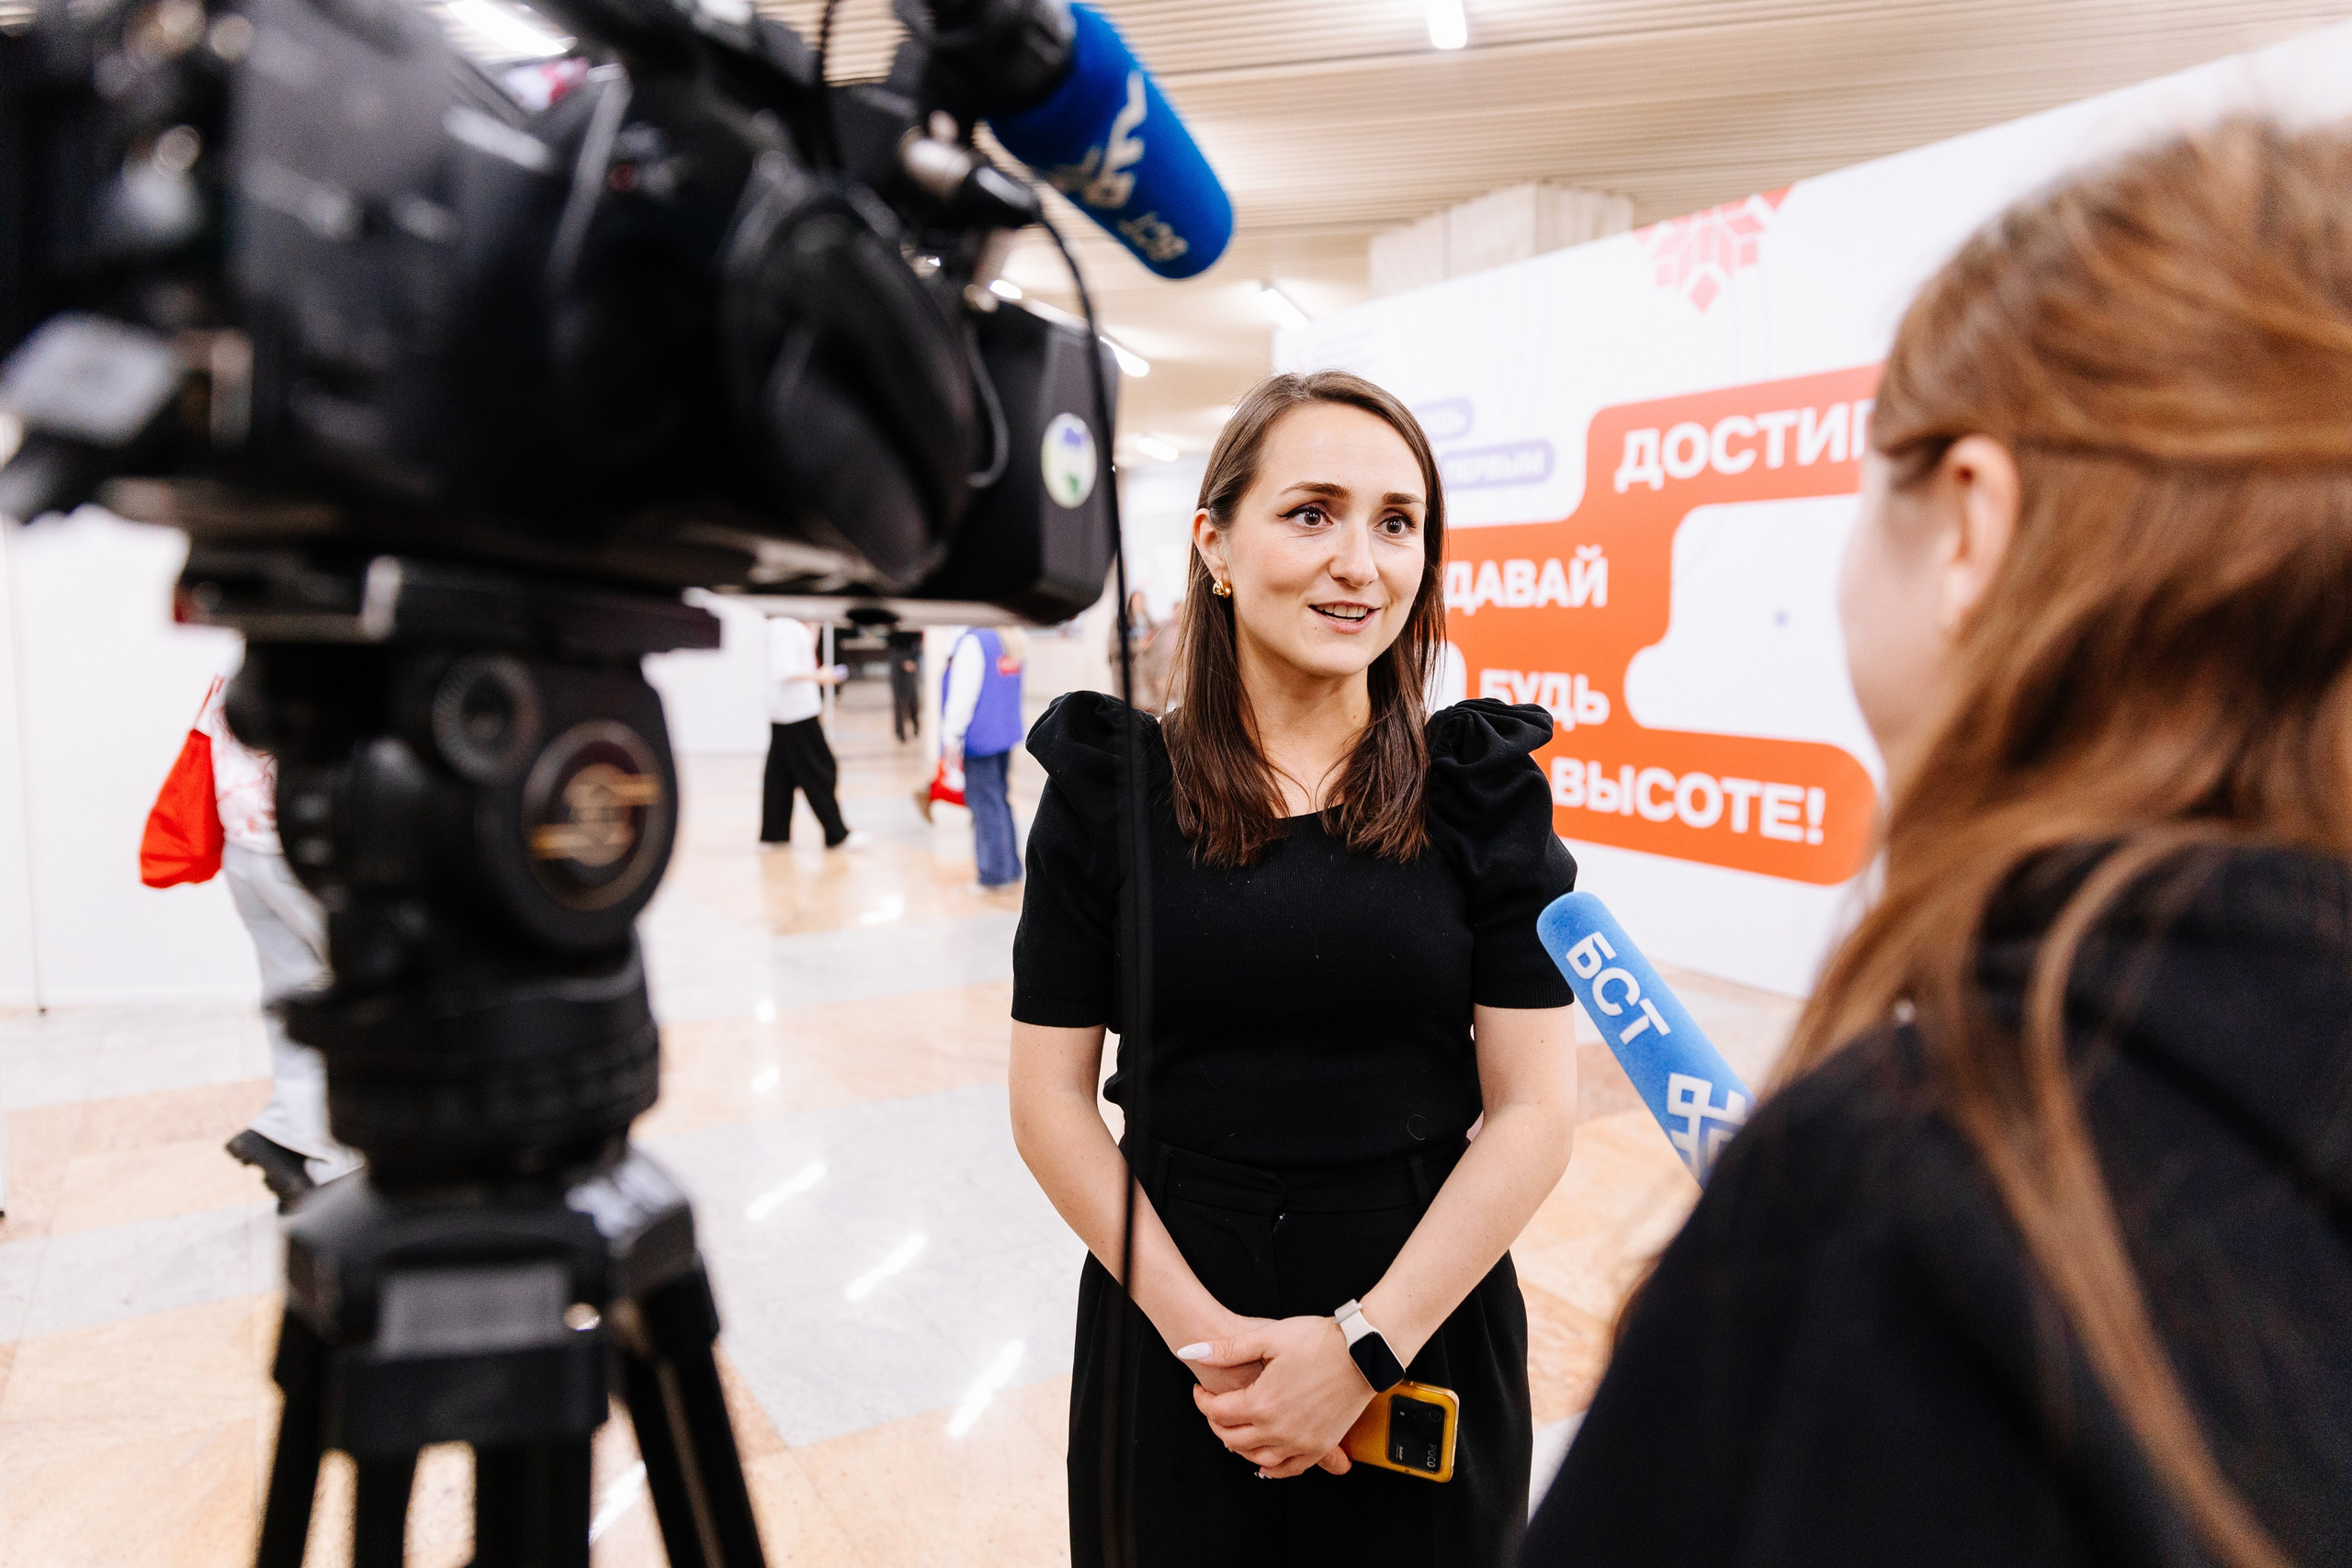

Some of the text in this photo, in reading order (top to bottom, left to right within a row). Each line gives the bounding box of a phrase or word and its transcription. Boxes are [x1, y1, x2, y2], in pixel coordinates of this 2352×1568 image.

[1444, 544, 1608, 616] ДАВАЙ
[1480, 668, 1611, 732] БУДЬ
[1551, 756, 1826, 845] ВЫСОТЕ!
[1565, 930, 1672, 1046] БСТ
[1427, 1444, 1437, 1468] POCO
